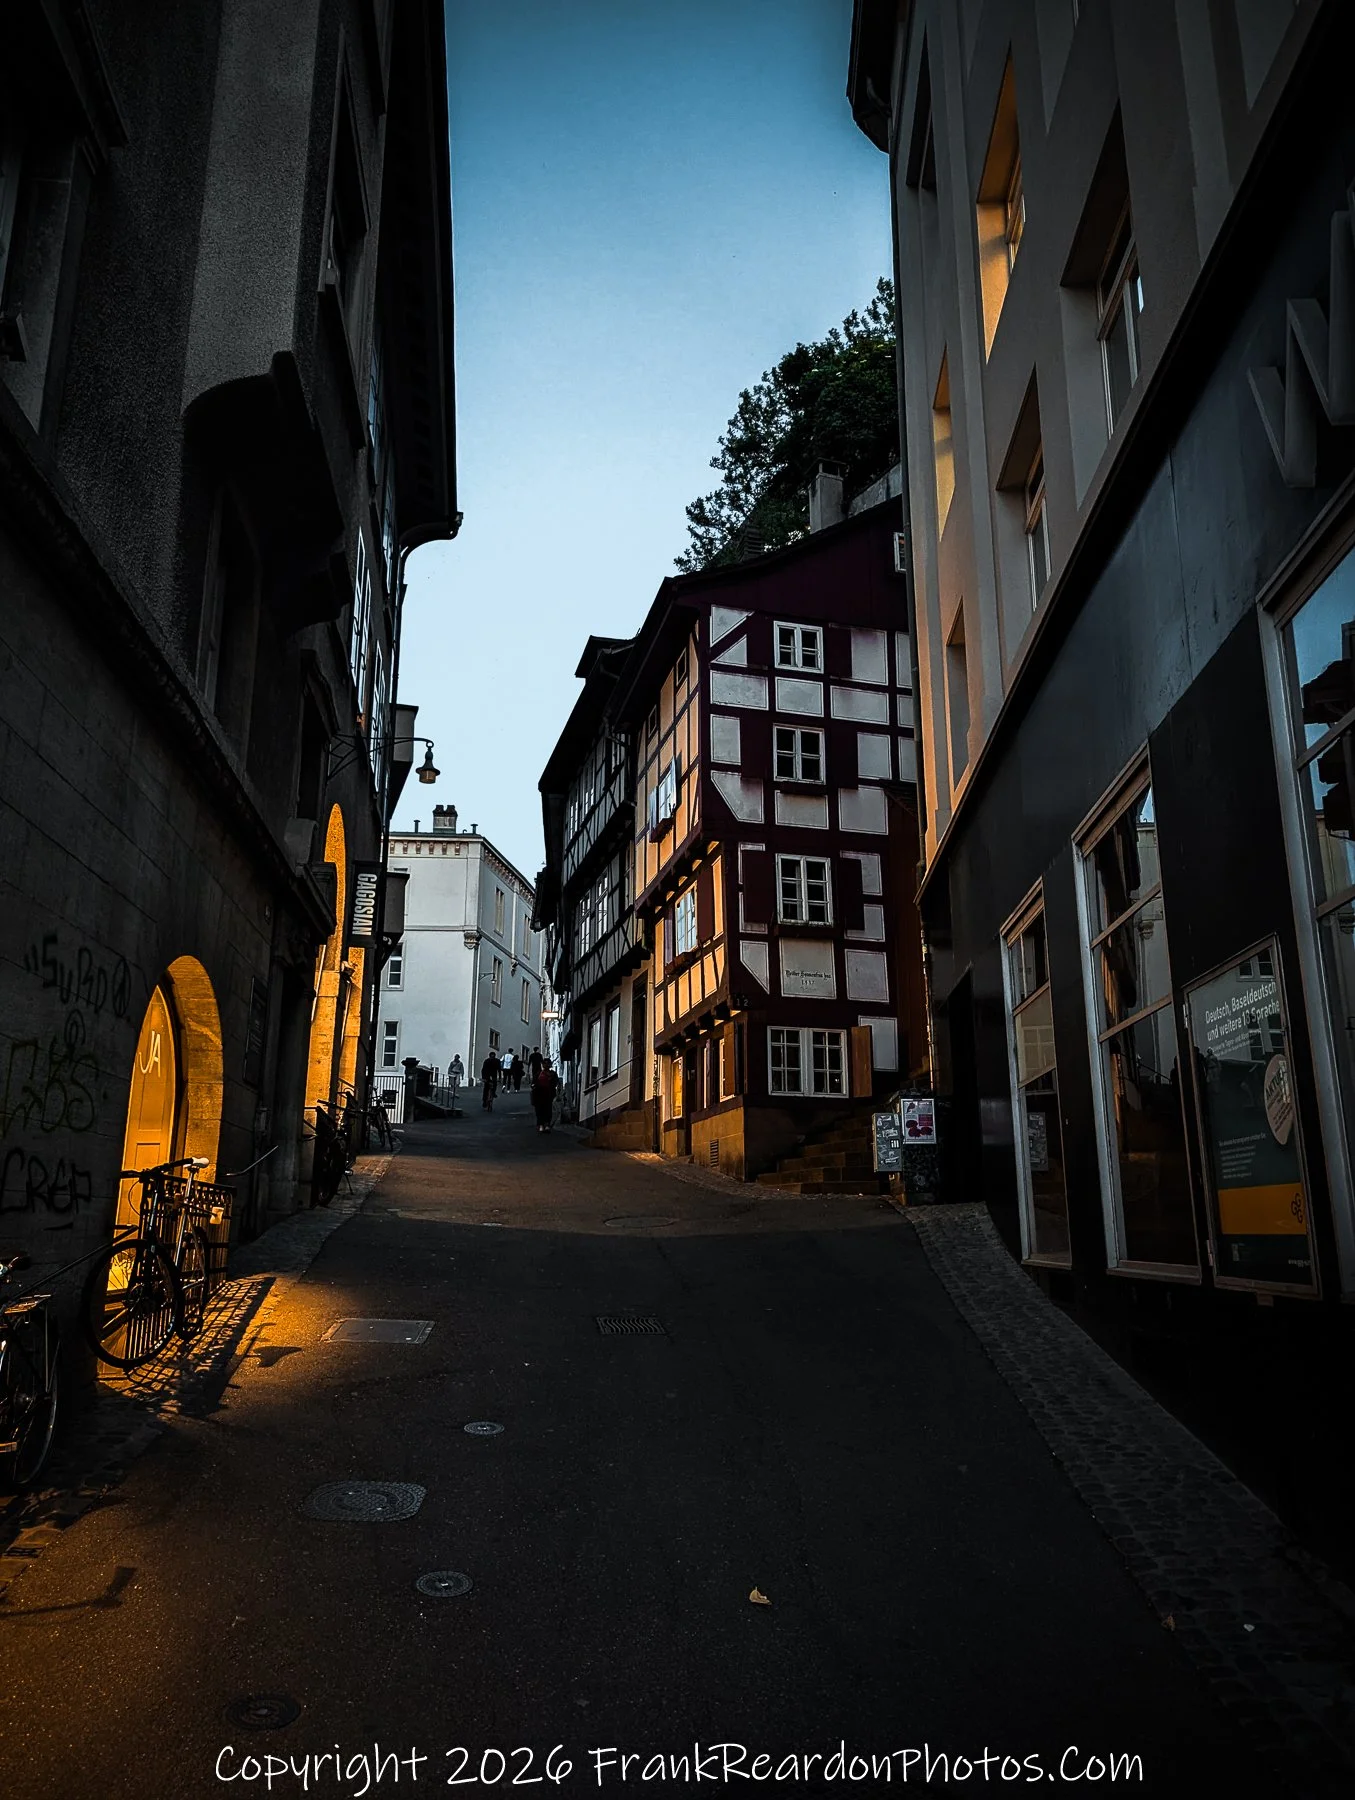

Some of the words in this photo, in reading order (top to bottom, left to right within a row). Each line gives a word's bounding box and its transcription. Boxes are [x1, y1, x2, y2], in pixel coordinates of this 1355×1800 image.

[352, 873, 378, 936] GAGOSIAN
[1205, 1001, 1231, 1024] Deutsch,
[1231, 979, 1277, 1012] Baseldeutsch
[1207, 1024, 1219, 1041] und
[1219, 1017, 1242, 1037] weitere
[1251, 998, 1281, 1026] Sprache
